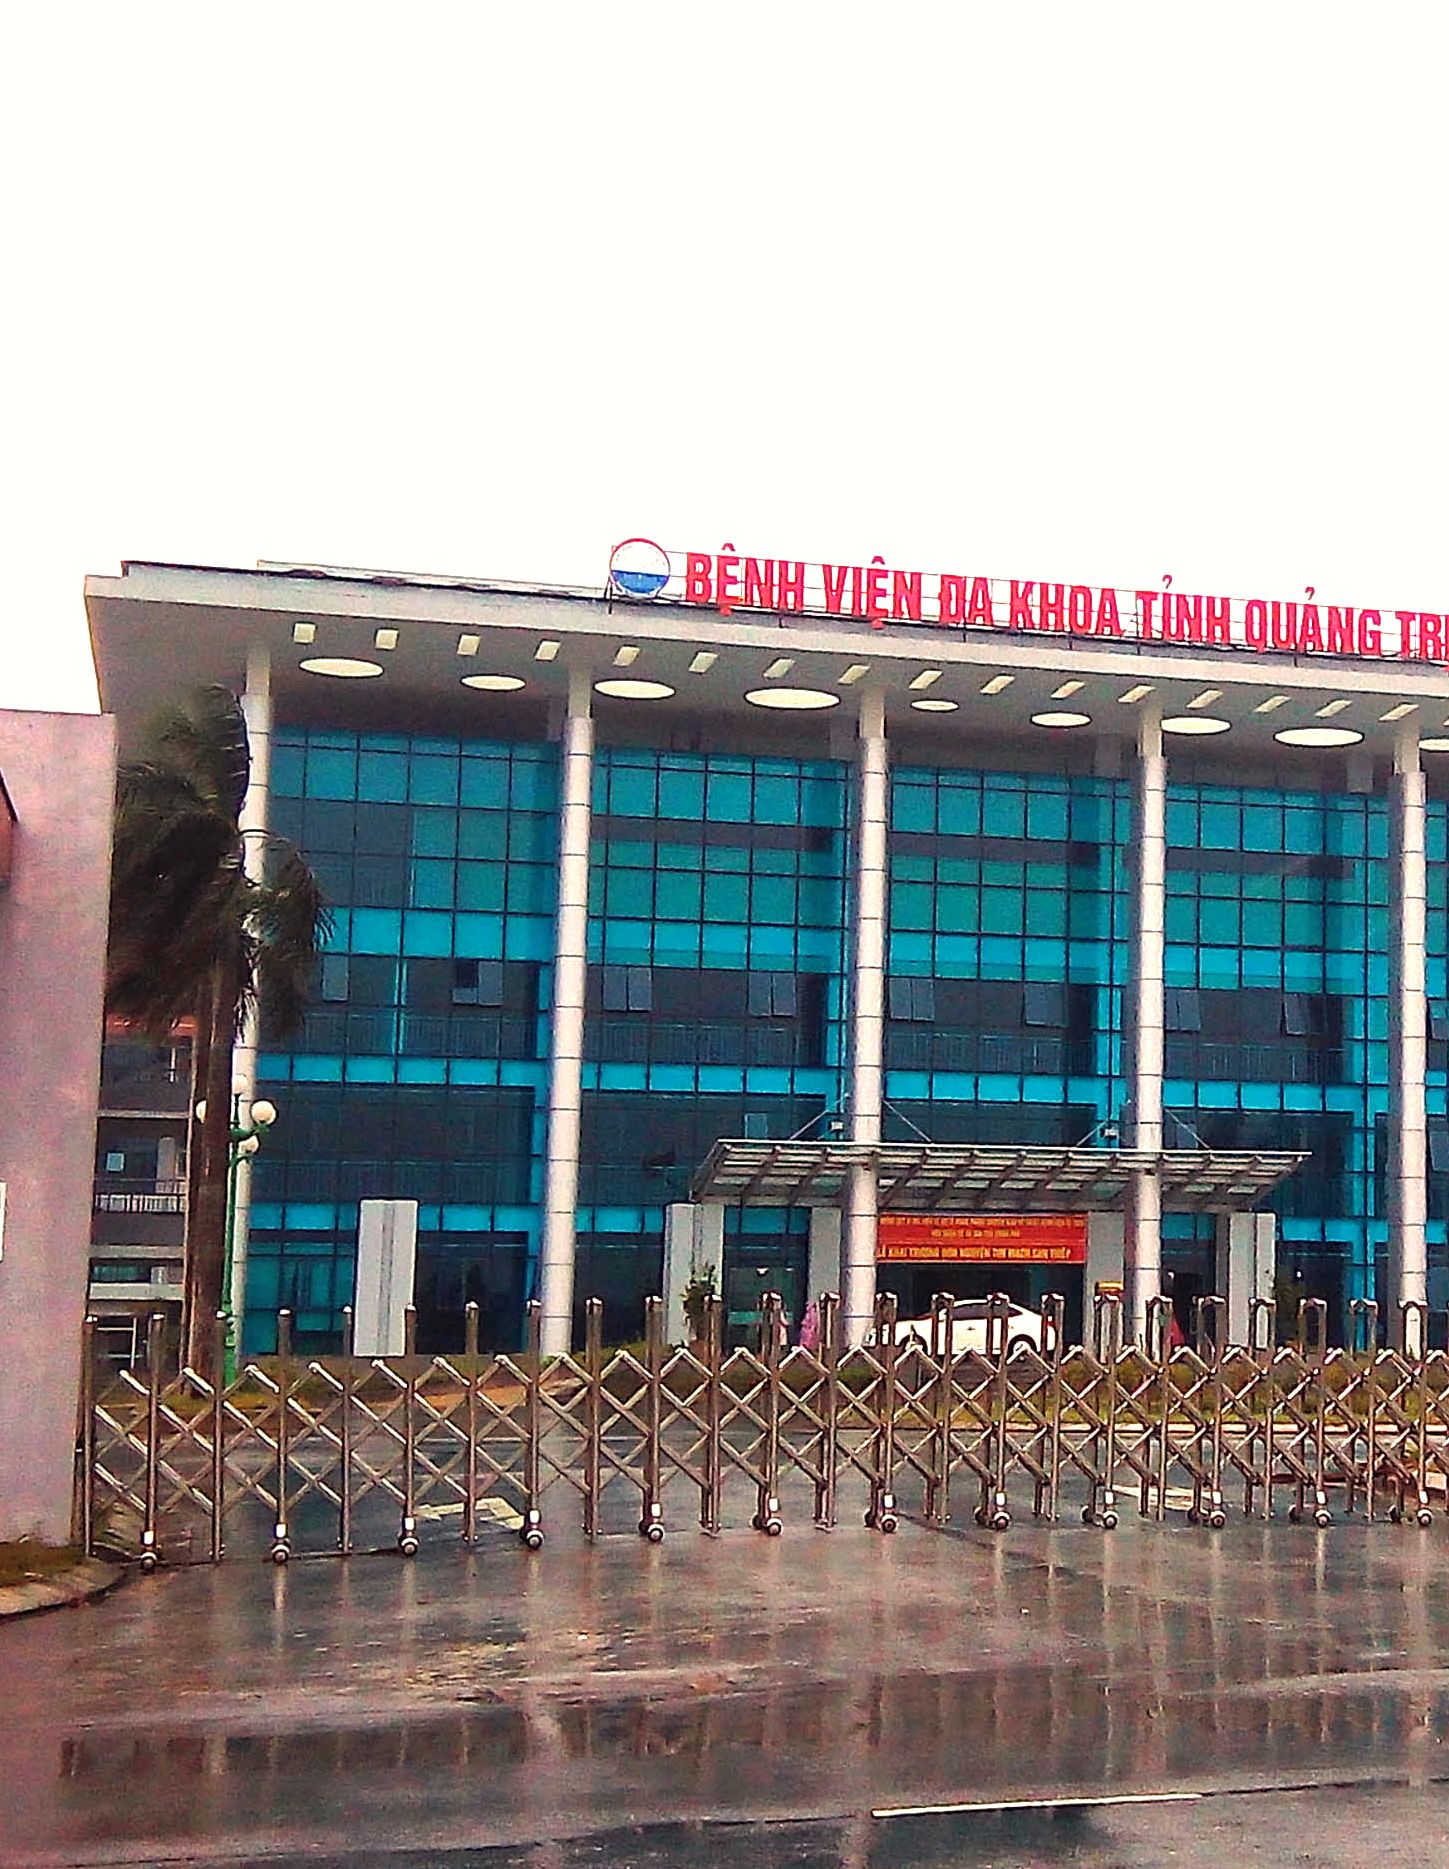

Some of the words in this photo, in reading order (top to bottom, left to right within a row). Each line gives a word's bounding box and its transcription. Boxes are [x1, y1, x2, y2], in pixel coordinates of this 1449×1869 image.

[685, 543, 805, 617] BỆNH
[823, 555, 922, 630] VIỆN
[938, 574, 994, 626] ĐA
[1010, 579, 1123, 636] KHOA
[1135, 575, 1231, 644] TỈNH
[1245, 587, 1382, 656] QUẢNG
